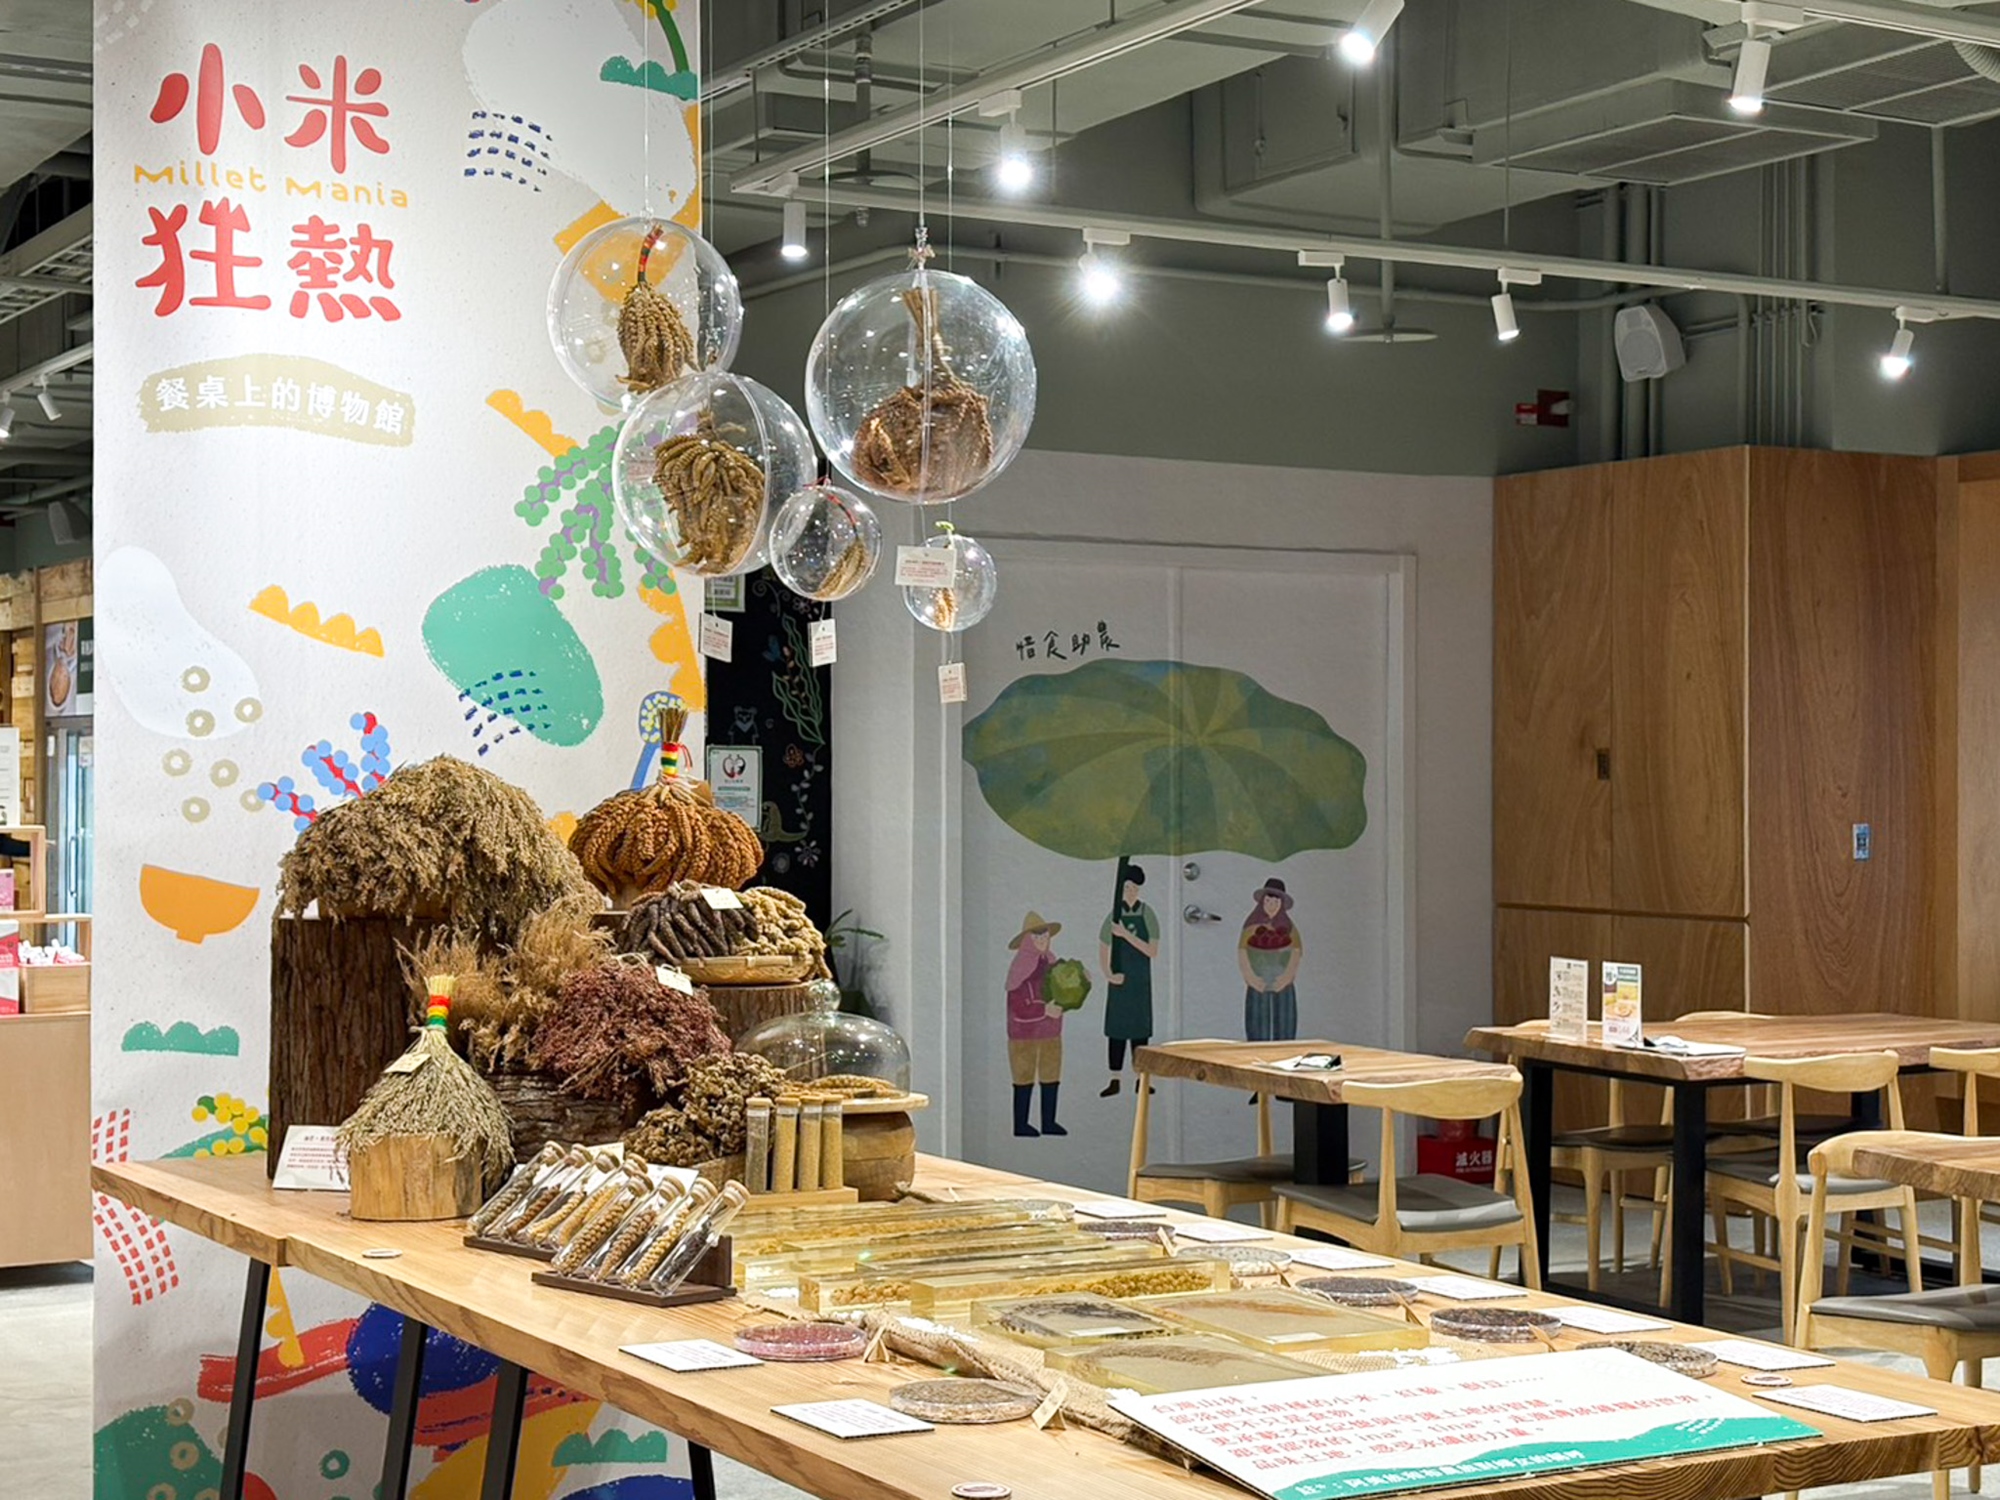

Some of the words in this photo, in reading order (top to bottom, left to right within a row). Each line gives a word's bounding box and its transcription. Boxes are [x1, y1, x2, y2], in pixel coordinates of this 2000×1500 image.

[149, 43, 389, 173] 小米
[134, 160, 266, 192] Millet
[287, 178, 408, 209] Mania
[135, 197, 401, 323] 狂熱
[156, 375, 406, 434] 餐桌上的博物館
[1016, 620, 1120, 661] 惜食助農
[1456, 1150, 1493, 1167] 滅火器
